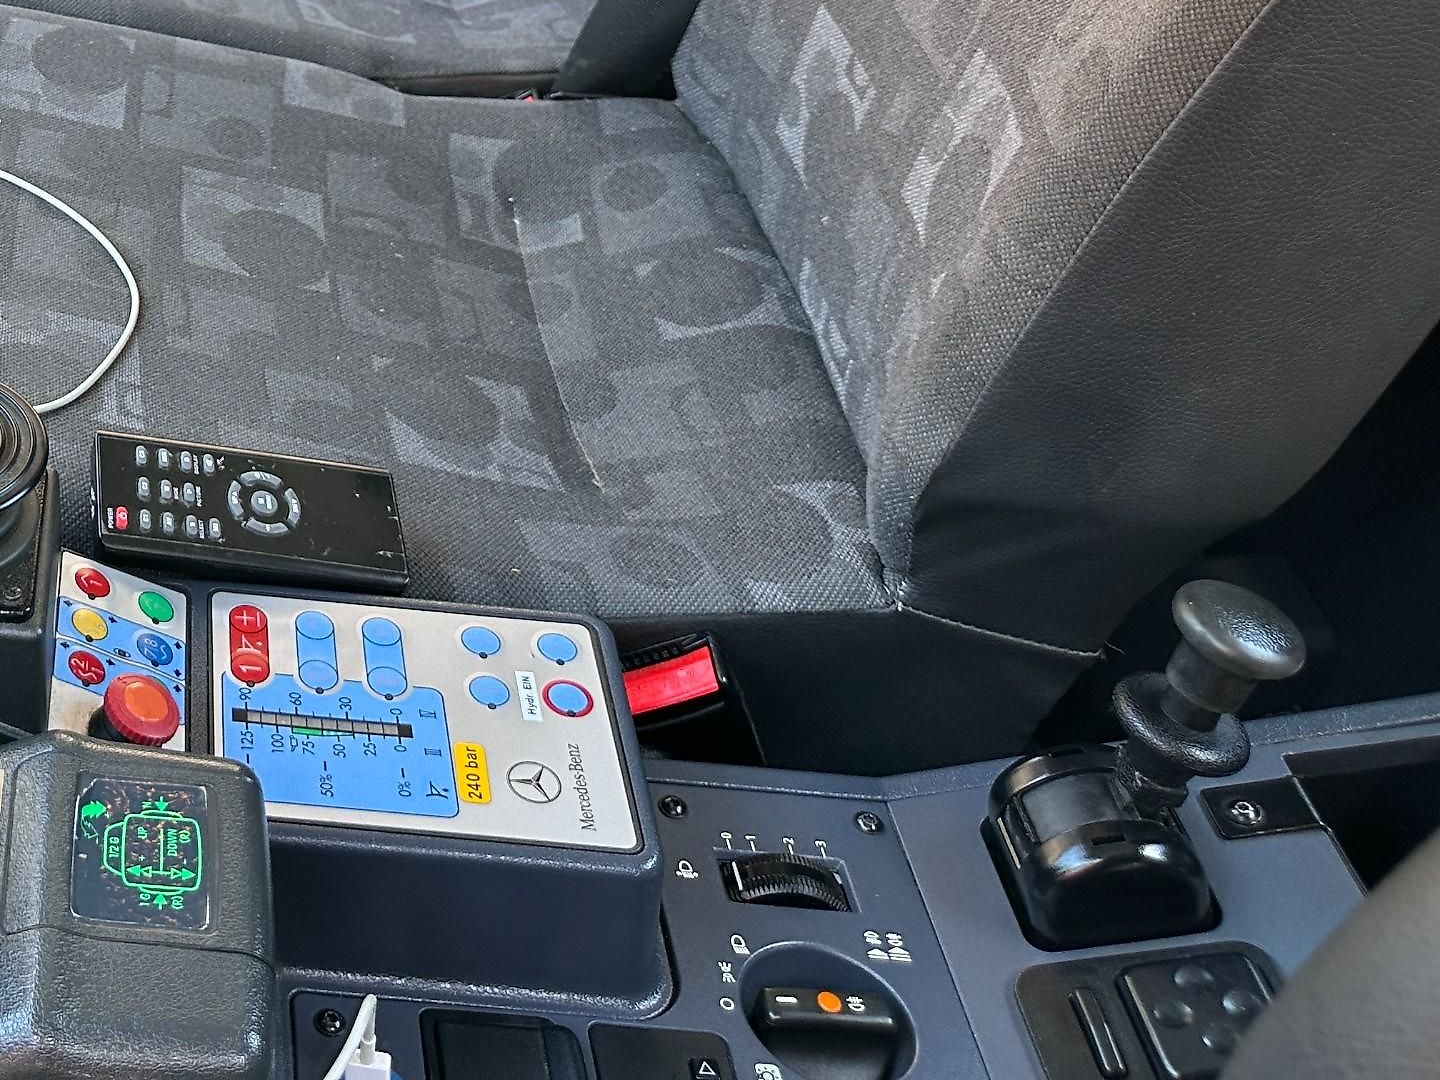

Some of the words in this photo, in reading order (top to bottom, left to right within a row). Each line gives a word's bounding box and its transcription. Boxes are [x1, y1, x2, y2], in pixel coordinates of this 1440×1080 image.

[521, 675, 532, 690] EIN
[239, 687, 252, 701] 90
[288, 692, 302, 706] 60
[338, 696, 353, 711] 30
[389, 708, 403, 716] 0
[240, 729, 255, 751] 125
[271, 733, 285, 754] 100
[302, 740, 315, 755] 75
[333, 743, 346, 759] 50
[363, 742, 377, 757] 25
[393, 744, 408, 753] 0
[464, 745, 478, 770] bar
[320, 773, 335, 798] 50%
[398, 781, 412, 798] 0%
[465, 773, 483, 800] 240
[567, 743, 597, 831] Mercedes-Benz
[167, 828, 178, 857] DOWN
[720, 831, 732, 839] 0
[782, 837, 795, 845] 2
[814, 840, 827, 848] 3
[171, 896, 184, 910] (R)
